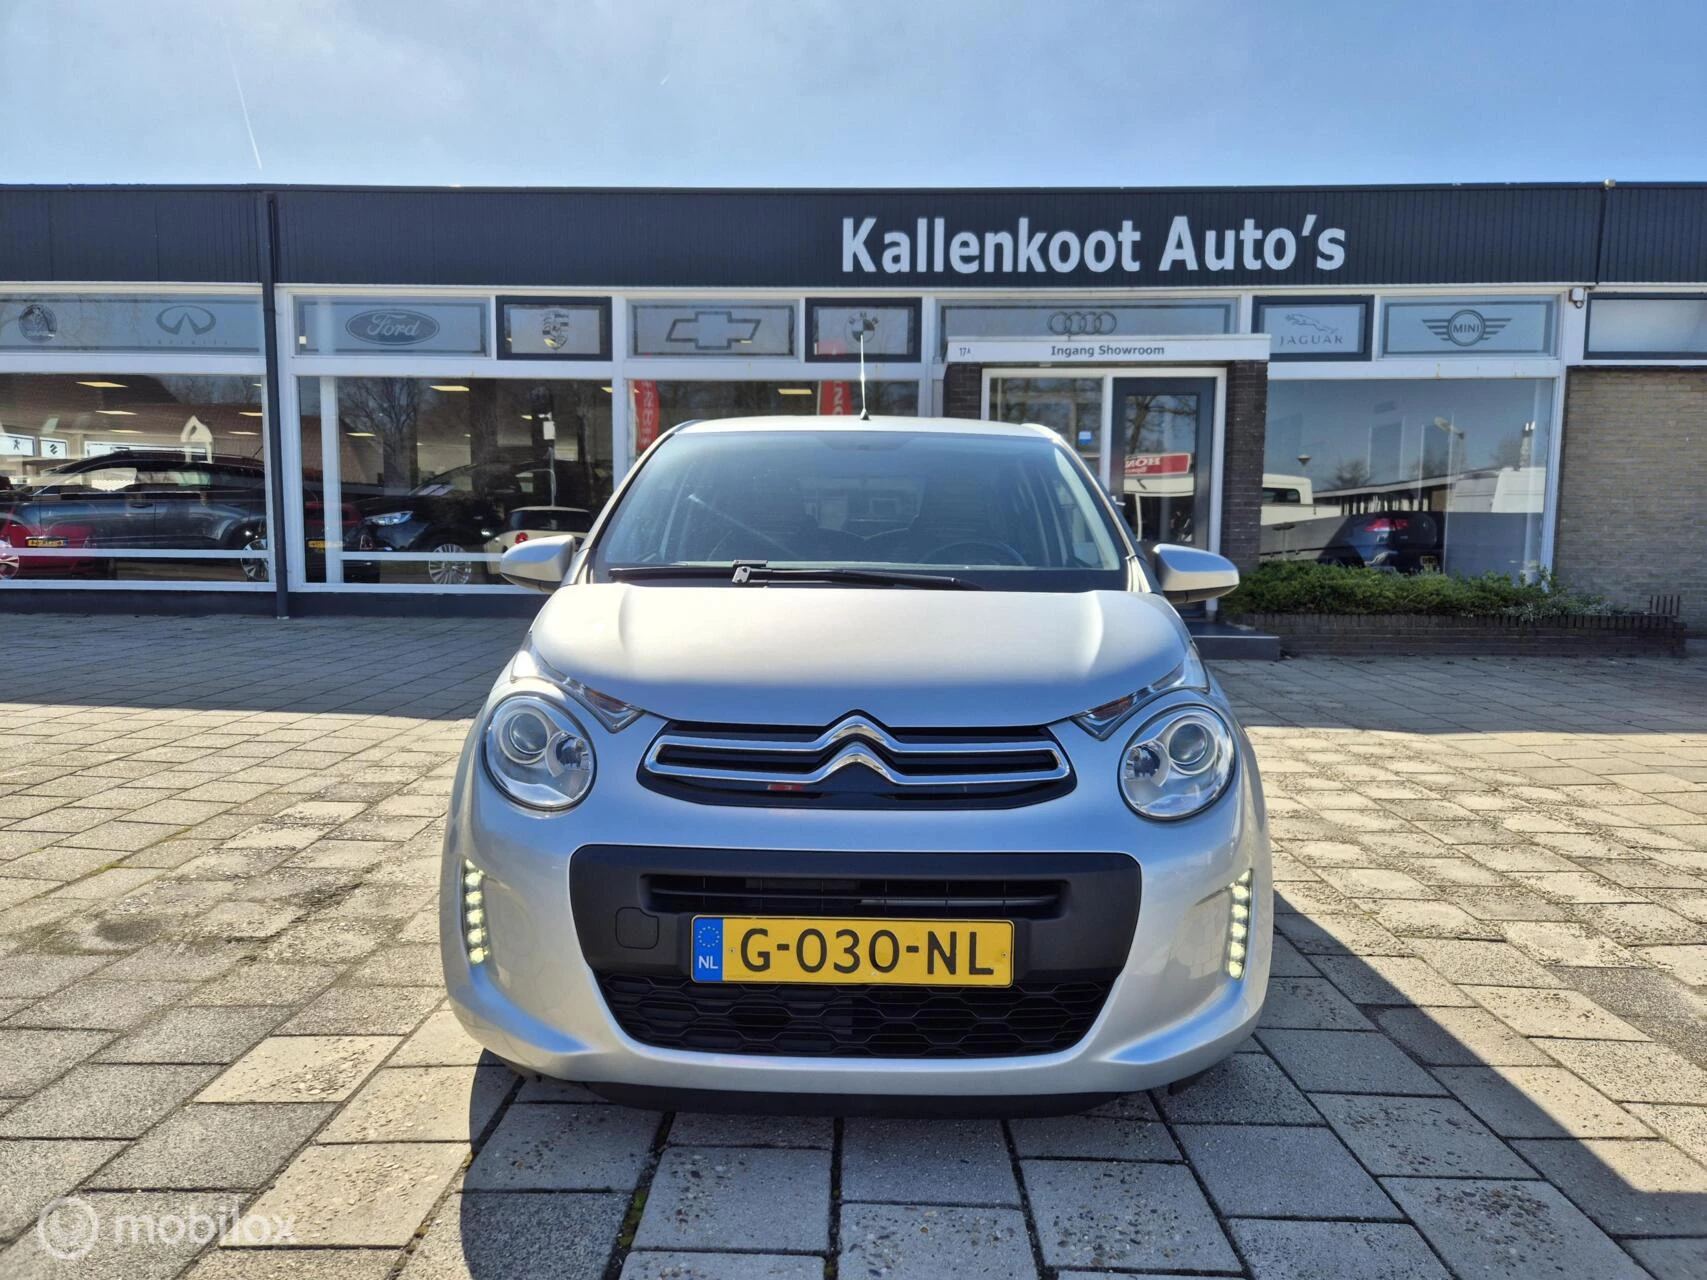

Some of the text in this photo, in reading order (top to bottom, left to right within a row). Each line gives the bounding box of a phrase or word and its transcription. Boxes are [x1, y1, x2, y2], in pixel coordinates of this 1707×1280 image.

[842, 214, 1346, 273] Kallenkoot Auto's
[367, 314, 420, 336] Ford
[1452, 323, 1480, 333] MINI
[1279, 335, 1344, 347] JAGUAR
[1051, 344, 1165, 358] Ingang Showroom
[740, 928, 994, 975] G-030-NL
[698, 955, 718, 969] NL
